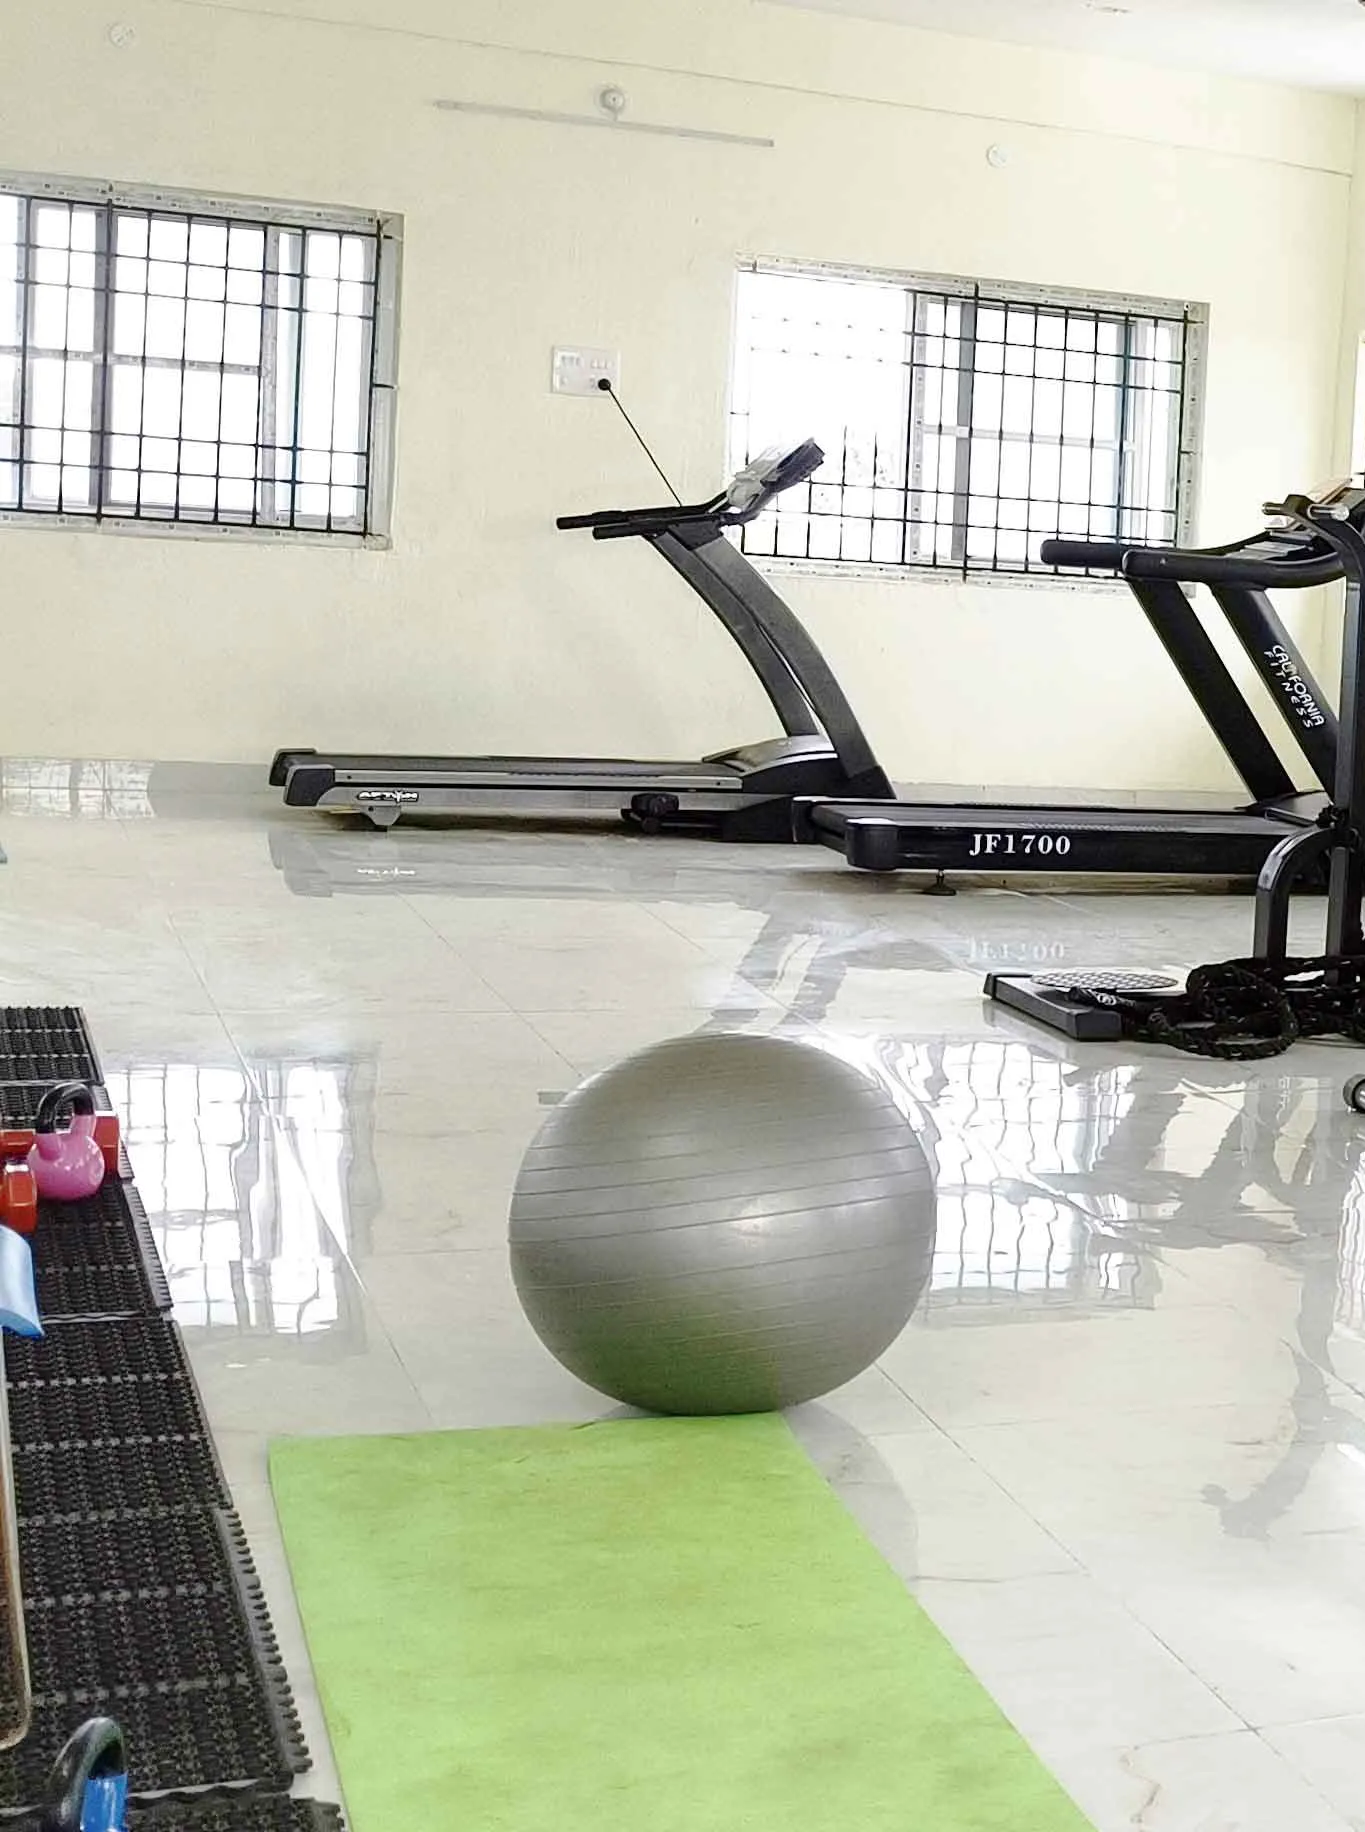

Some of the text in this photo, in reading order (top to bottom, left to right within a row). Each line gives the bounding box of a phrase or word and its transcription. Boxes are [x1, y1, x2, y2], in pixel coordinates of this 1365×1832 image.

[1263, 650, 1314, 728] FITNESS
[1272, 644, 1325, 726] CALIFORNIA
[968, 833, 1071, 856] JF1700
